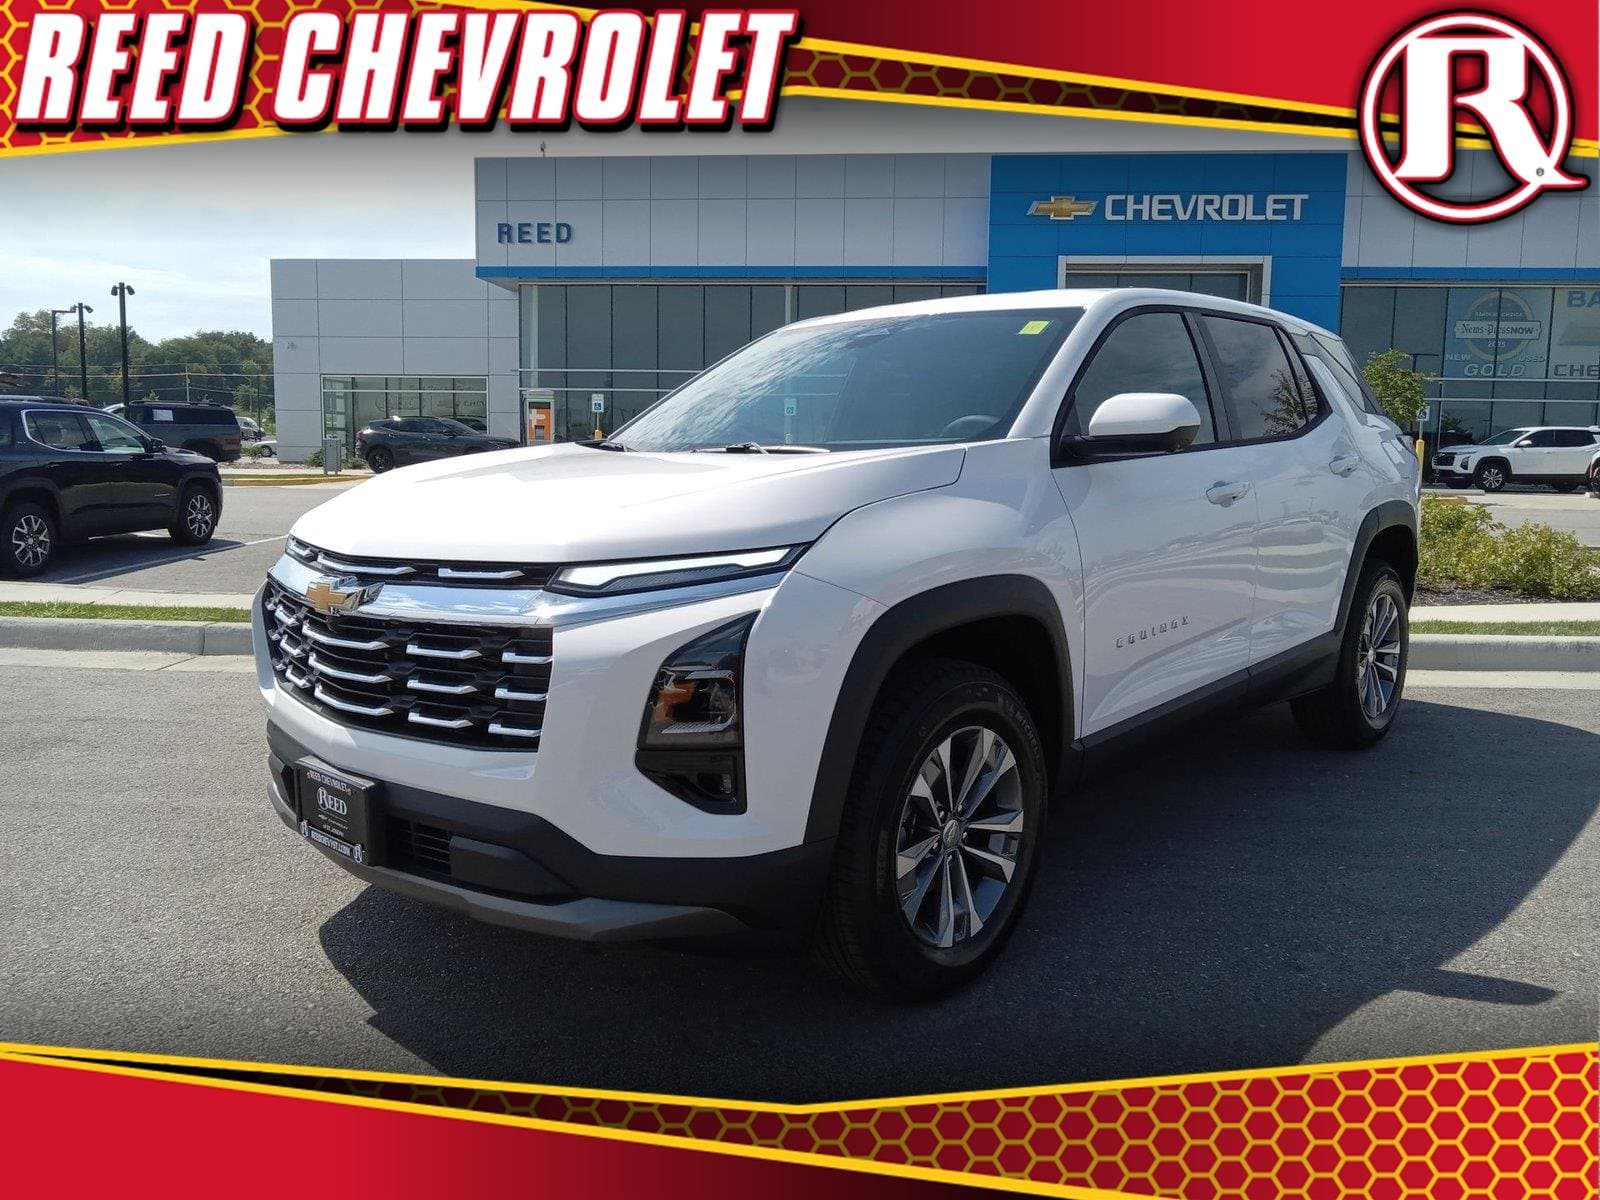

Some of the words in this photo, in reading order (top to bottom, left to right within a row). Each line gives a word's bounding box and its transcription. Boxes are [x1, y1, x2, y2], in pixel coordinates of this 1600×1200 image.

[1104, 194, 1309, 221] CHEVROLET
[497, 222, 573, 243] REED
[1445, 353, 1472, 361] NEW
[1464, 363, 1526, 377] GOLD
[1115, 615, 1190, 649] EQUINOX
[316, 786, 348, 816] REED
